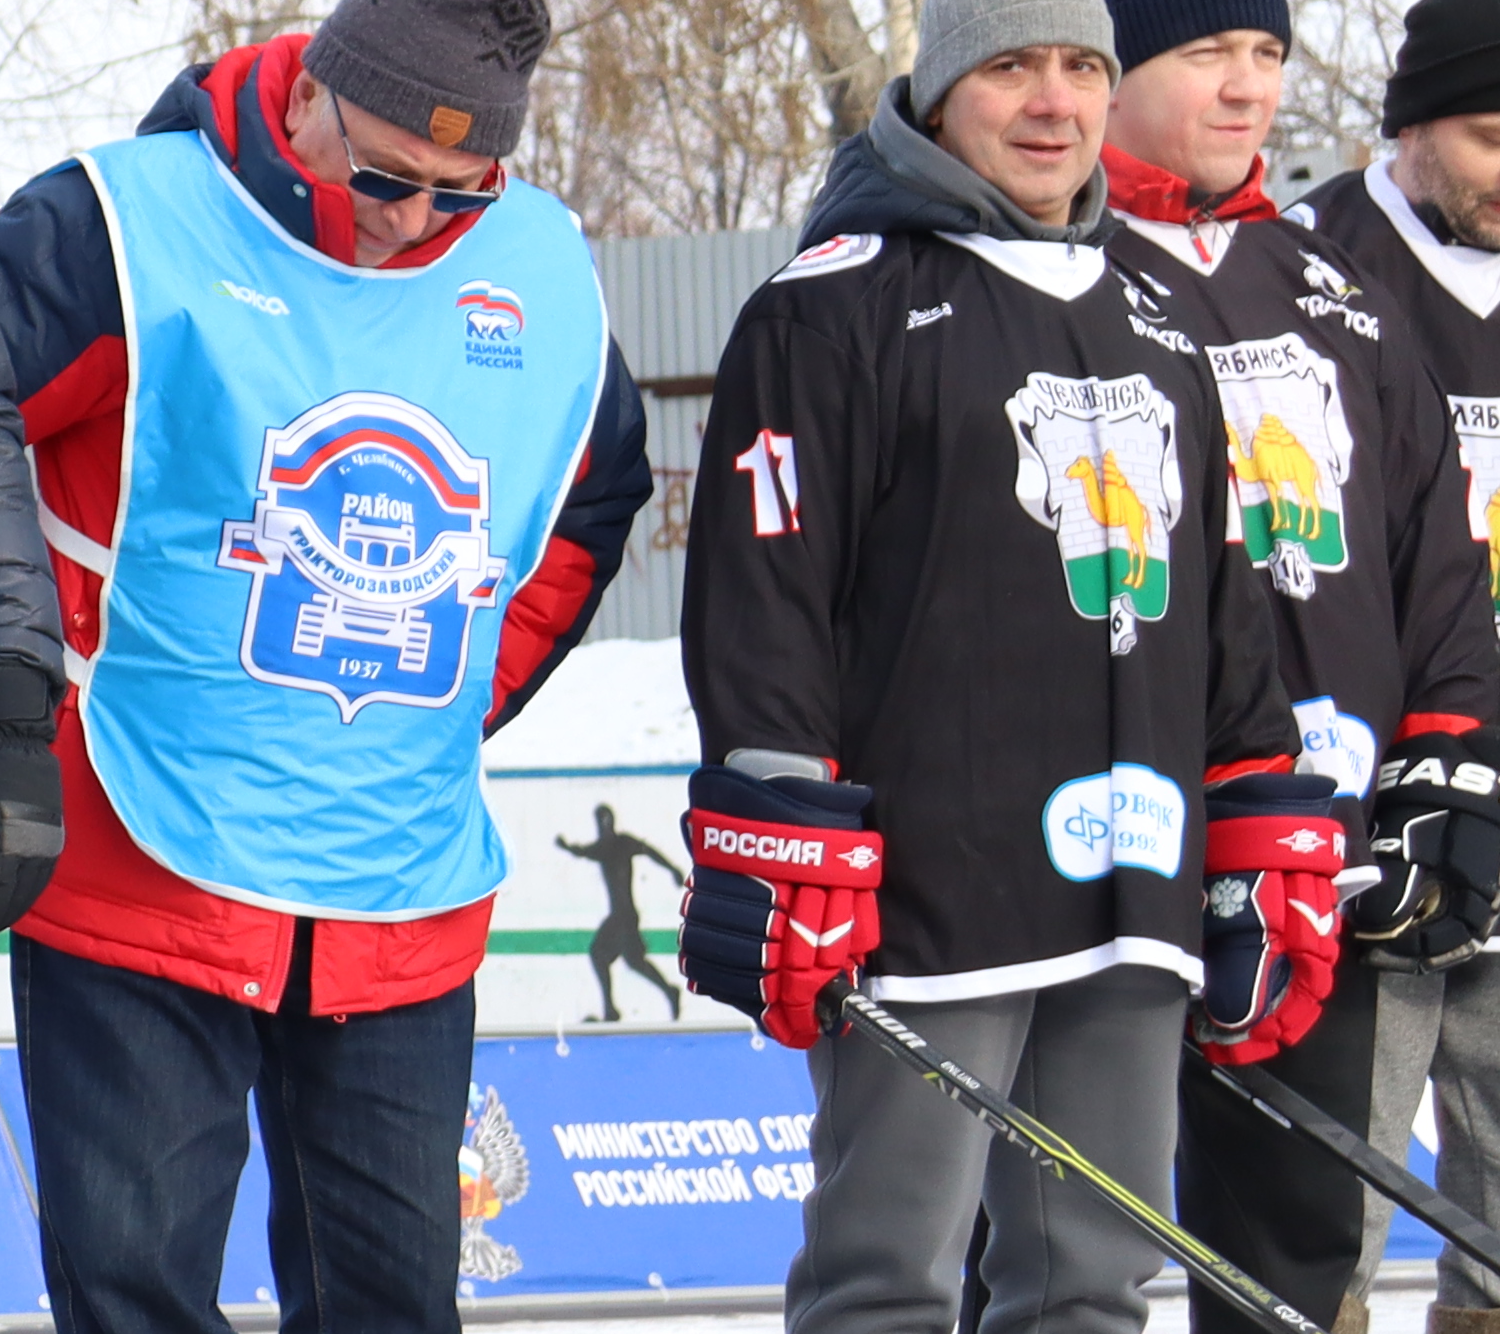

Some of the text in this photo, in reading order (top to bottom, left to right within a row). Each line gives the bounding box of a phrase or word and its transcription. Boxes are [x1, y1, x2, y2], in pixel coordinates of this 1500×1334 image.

[465, 341, 523, 357] ЕДИНАЯ
[466, 353, 524, 370] РОССИЯ
[1213, 344, 1299, 374] ЯБИНСК
[1036, 379, 1146, 413] ЧЕЛЯБНСК
[341, 491, 415, 524] РАЙОН
[286, 522, 458, 596] ТРАКТОРОЗАВОДСКИЙ
[337, 657, 383, 680] 1937
[703, 825, 824, 868] РОССИЯ
[552, 1115, 759, 1161] МИНИСТЕРСТВО
[572, 1159, 752, 1209] РОССИЙСКОЙ
